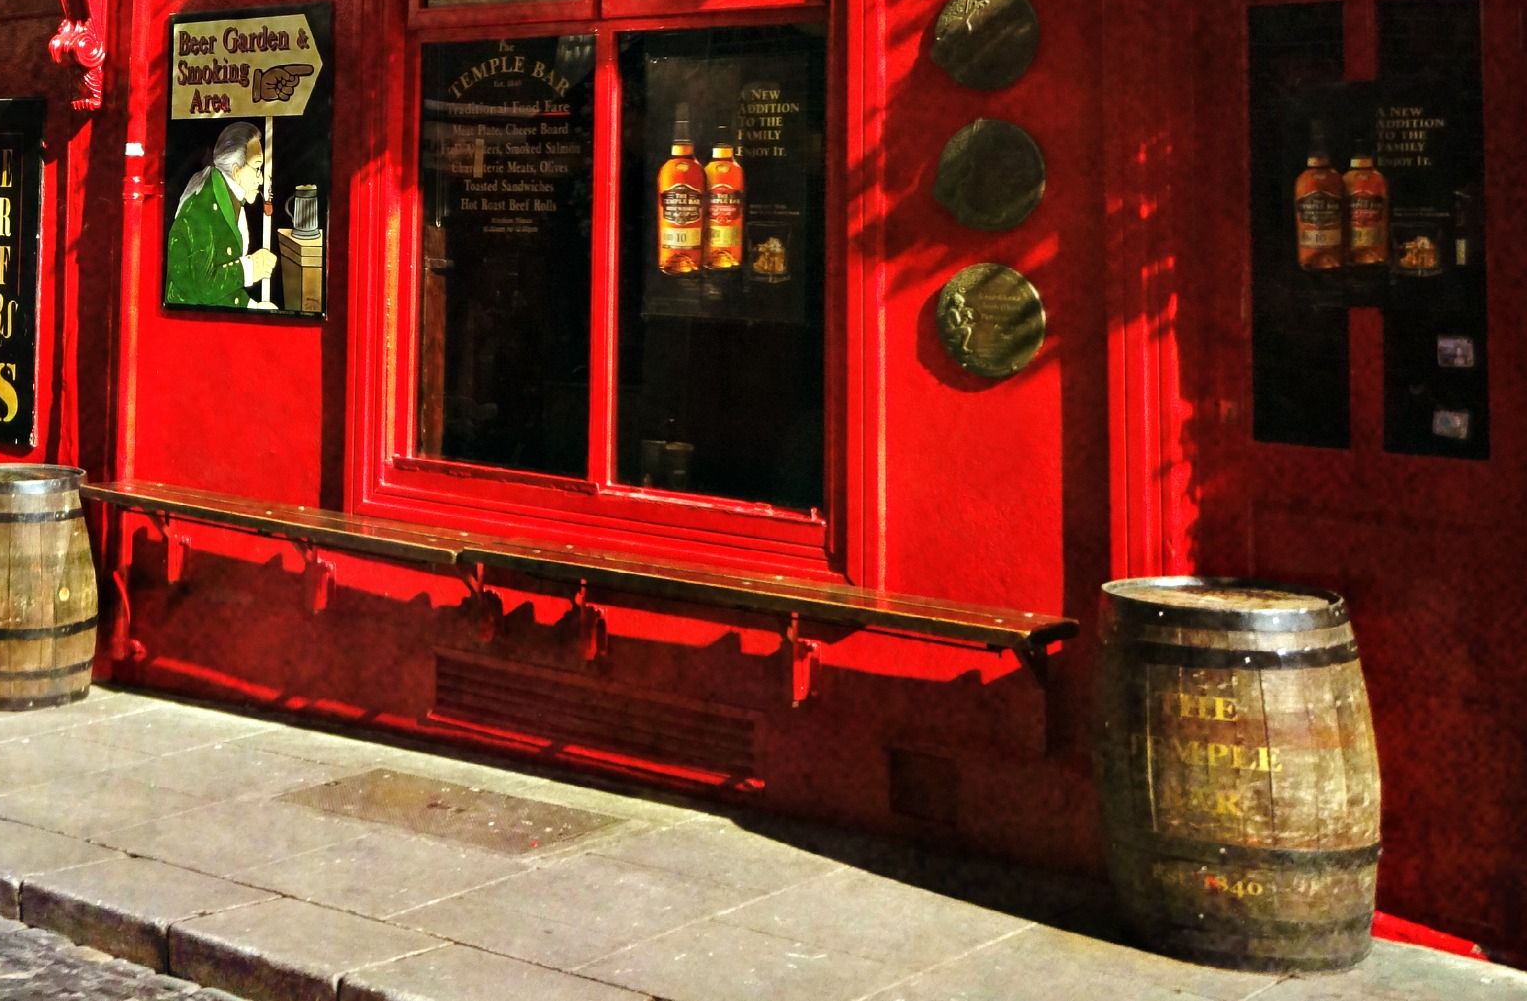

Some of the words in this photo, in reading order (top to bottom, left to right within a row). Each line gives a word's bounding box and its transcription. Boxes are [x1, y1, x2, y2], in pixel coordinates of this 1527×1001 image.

[178, 30, 217, 56] Beer
[222, 25, 290, 53] Garden
[296, 28, 310, 49] &
[177, 58, 250, 88] Smoking
[448, 55, 526, 99] TEMPLE
[531, 60, 571, 98] BAR
[190, 88, 231, 114] Area
[544, 100, 571, 112] Fare
